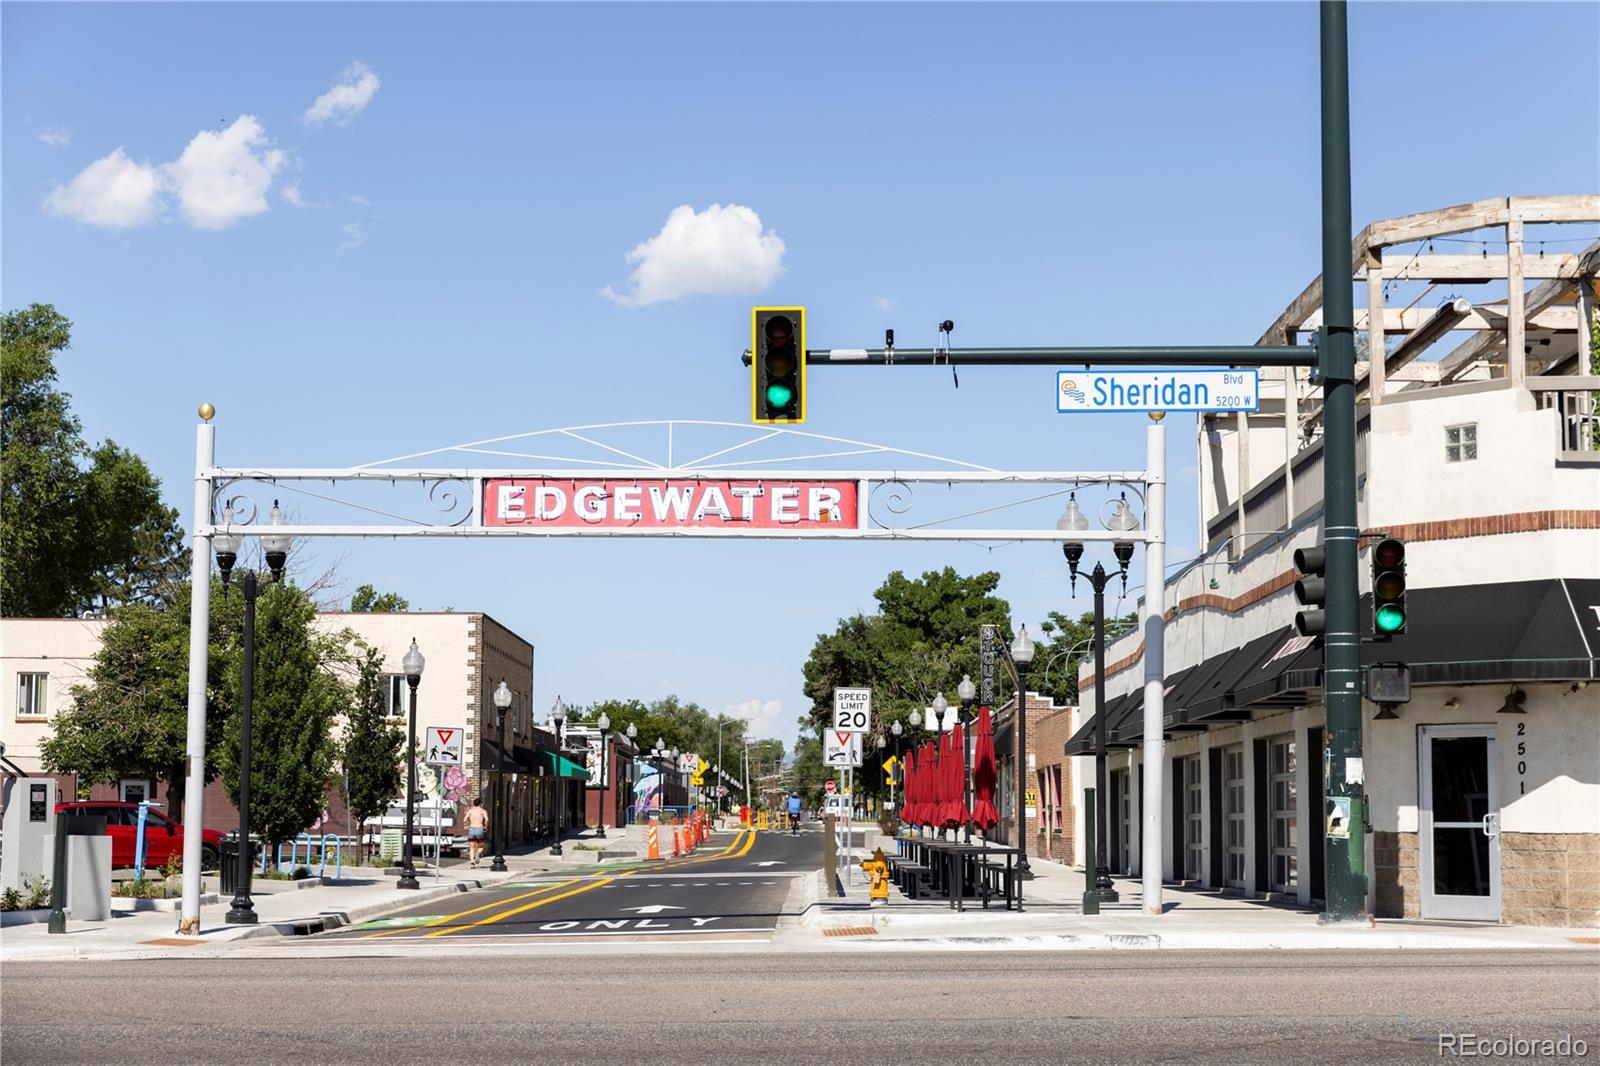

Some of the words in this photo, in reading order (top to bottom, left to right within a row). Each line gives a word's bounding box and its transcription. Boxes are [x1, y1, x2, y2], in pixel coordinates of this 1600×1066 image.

[1223, 374, 1244, 385] Blvd
[1093, 376, 1209, 406] Sheridan
[1215, 396, 1241, 407] 5200
[1243, 396, 1252, 406] W
[496, 484, 844, 524] EDGEWATER
[838, 693, 868, 701] SPEED
[841, 702, 864, 710] LIMIT
[838, 711, 867, 728] 20
[1517, 722, 1527, 795] 2501
[539, 916, 722, 931] ONLY
